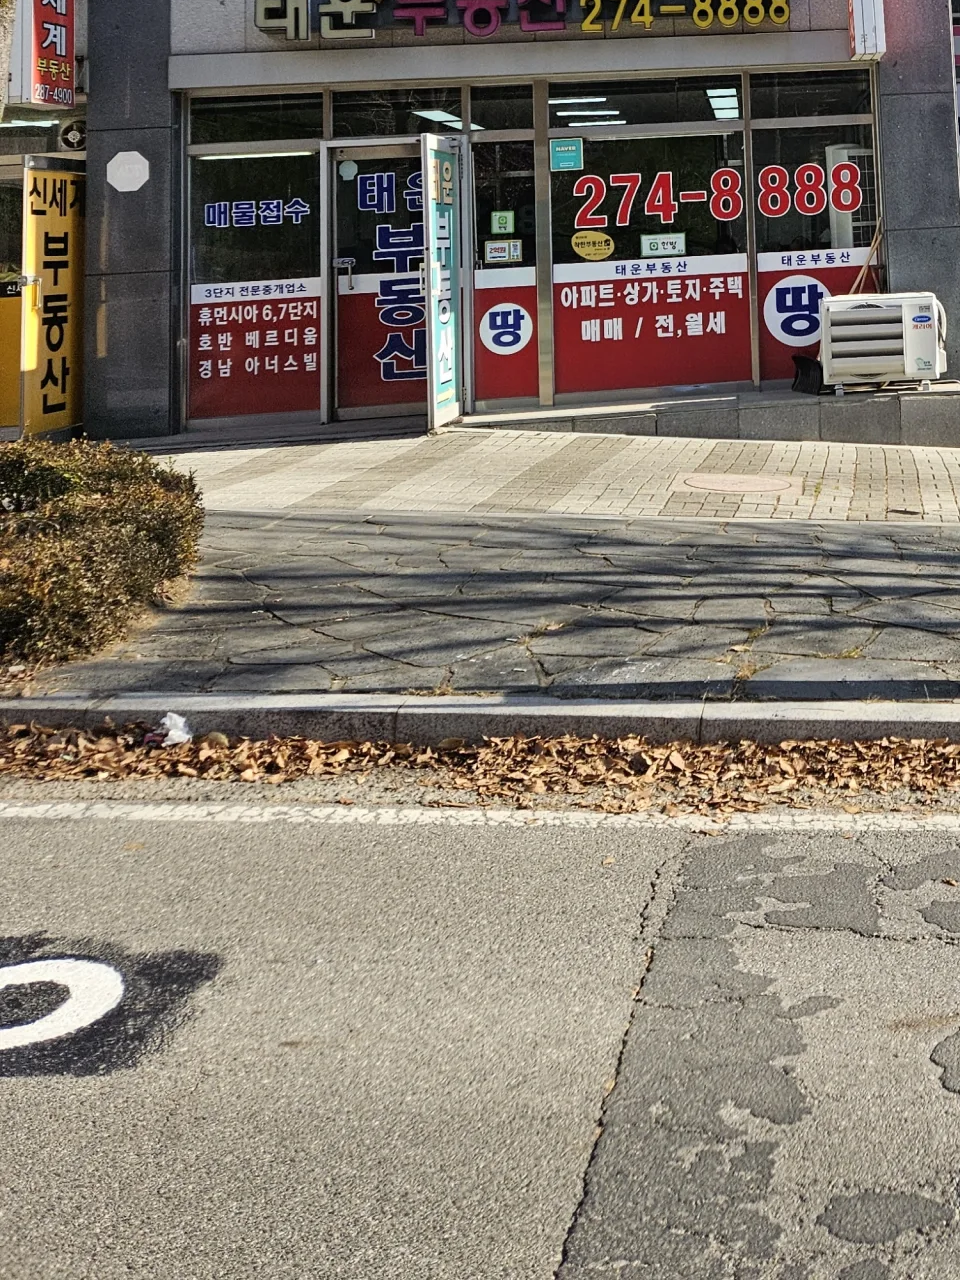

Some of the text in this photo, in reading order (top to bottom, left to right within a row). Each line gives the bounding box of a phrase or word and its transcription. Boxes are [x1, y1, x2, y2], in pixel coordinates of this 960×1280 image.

[36, 57, 71, 82] 부동산
[34, 83, 73, 105] 287-4900
[573, 161, 863, 228] 274-8888
[204, 197, 310, 228] 매물접수
[615, 260, 689, 276] 태운부동산
[781, 251, 852, 267] 태운부동산
[204, 282, 307, 299] 3단지 전문중개업소
[40, 230, 70, 416] 부동산
[197, 300, 318, 327] 휴먼시아 6,7단지
[775, 283, 824, 337] 땅
[197, 327, 318, 352] 호반 베르디움
[488, 308, 525, 347] 땅
[580, 317, 623, 343] 매매
[197, 352, 318, 379] 경남 아너스빌
